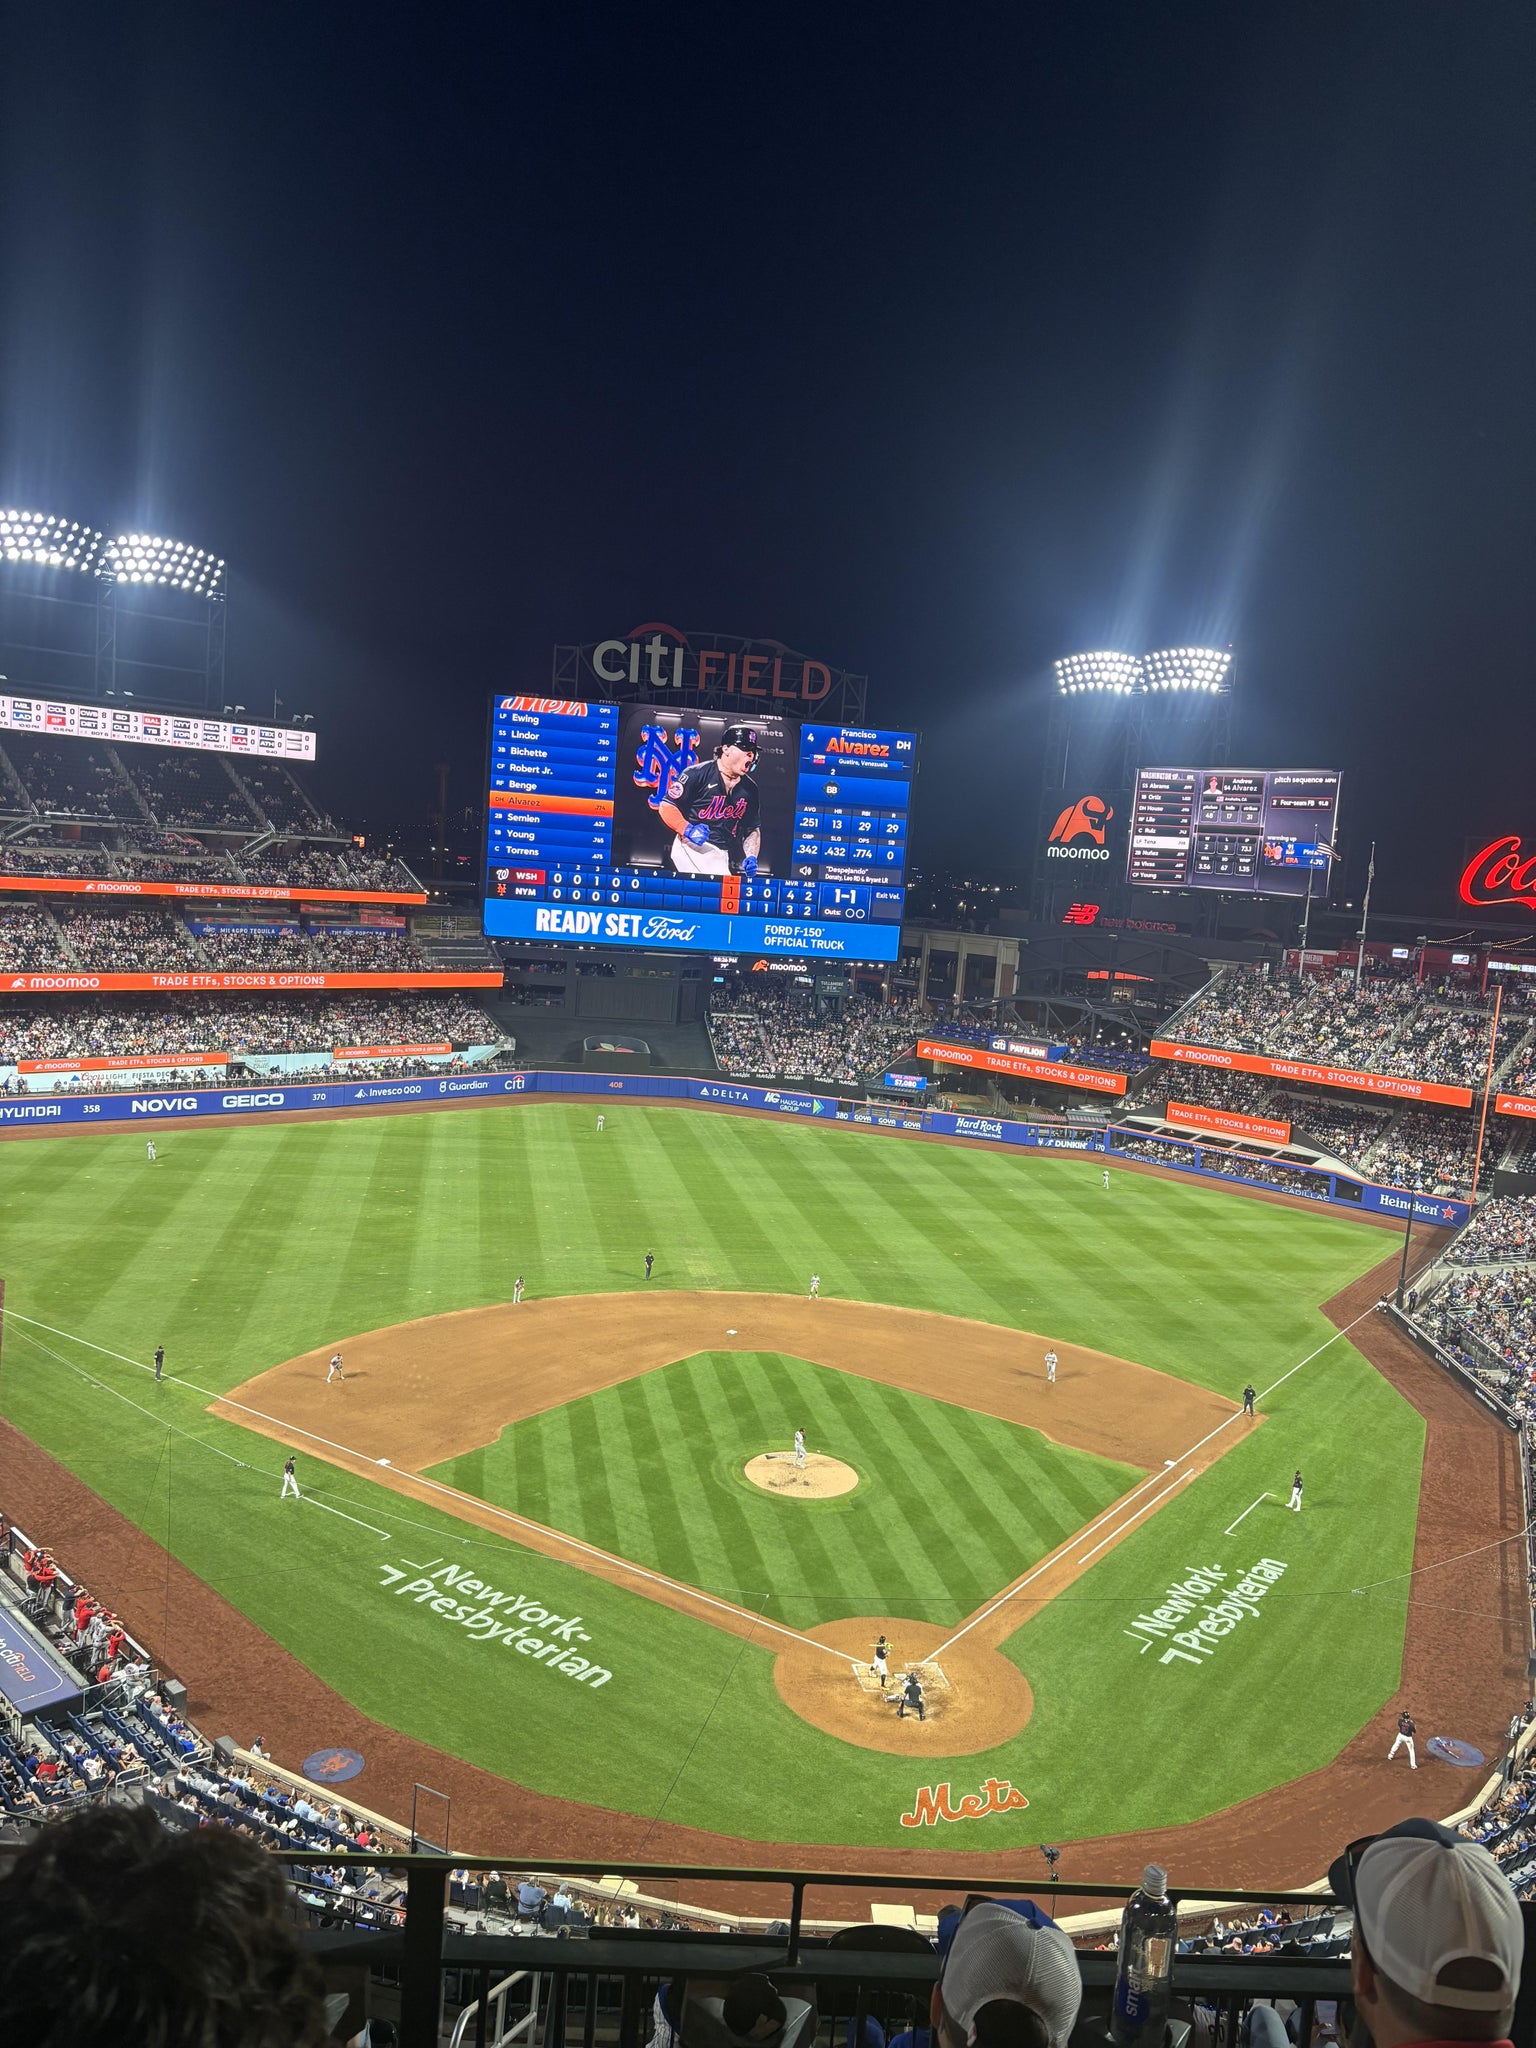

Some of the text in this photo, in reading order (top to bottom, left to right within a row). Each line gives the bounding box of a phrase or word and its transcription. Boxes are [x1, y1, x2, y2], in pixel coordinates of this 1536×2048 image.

[593, 634, 832, 701] citi FIELD
[174, 720, 190, 728] NYY
[512, 713, 540, 726] Ewing
[511, 730, 540, 741] Lindor
[807, 733, 815, 743] 4
[841, 729, 877, 739] Francisco
[826, 737, 890, 757] Alvarez
[896, 740, 911, 750] DH
[510, 746, 548, 758] Bichette
[509, 764, 553, 775] Robert Jr.
[509, 780, 538, 792] Benge
[1274, 776, 1324, 785] pitch sequence
[508, 796, 541, 807] Alvarez
[507, 813, 540, 824] Semien
[800, 818, 819, 828] .251
[832, 820, 843, 829] 13
[858, 822, 871, 831] 29
[886, 824, 899, 834] 29
[506, 829, 536, 842] Young
[505, 845, 540, 857] Torrens
[796, 845, 818, 855] .342
[824, 847, 846, 857] .432
[853, 849, 873, 859] .774
[886, 851, 895, 860] 0
[1047, 846, 1110, 861] moomoo
[97, 883, 142, 892] moomoo
[175, 886, 200, 894] TRADE
[201, 887, 220, 895] ETFs,
[221, 888, 251, 896] STOCKS
[258, 889, 291, 897] OPTIONS
[516, 871, 538, 881] WSH
[553, 873, 562, 883] 0
[573, 874, 582, 885] 0
[594, 876, 599, 886] 1
[612, 877, 621, 887] 0
[631, 878, 640, 889] 0
[745, 888, 753, 897] 3
[763, 889, 772, 899] 0
[787, 890, 795, 900] 4
[804, 892, 812, 901] 2
[515, 887, 537, 897] NYM
[552, 888, 562, 899] 0
[572, 890, 581, 900] 0
[592, 891, 601, 901] 0
[611, 892, 620, 903] 0
[726, 902, 734, 910] 0
[785, 905, 793, 915] 3
[803, 906, 811, 916] 2
[536, 908, 697, 942] READY SET Ford
[764, 924, 793, 936] FORD
[1126, 918, 1177, 933] balance
[763, 935, 845, 951] OFFICIAL TRUCK
[770, 963, 808, 972] moomoo
[30, 975, 326, 989] moomoo TRADE ETFs, STOCKS & OPTIONS
[1009, 1043, 1046, 1057] PAVILION
[44, 1061, 81, 1070] moomoo
[932, 1049, 1117, 1088] moomoo TRADE ETFs, STOCKS & OPTIONS
[1185, 1050, 1422, 1095] moomoo TRADE ETFs, STOCKS & OPTIONS
[448, 1080, 489, 1092] Guardian
[504, 1076, 525, 1090] citi
[608, 1081, 624, 1089] 408
[312, 1092, 326, 1101] 370
[369, 1085, 422, 1097] Invesco QQQ
[712, 1088, 749, 1101] DELTA
[131, 1098, 198, 1113] NOVIG
[222, 1093, 285, 1108] GEICO
[780, 1098, 812, 1108] HAUGLAND
[83, 1104, 101, 1113] 358
[779, 1104, 800, 1113] GROUP
[835, 1111, 849, 1120] 380
[853, 1114, 872, 1123] GOYA
[878, 1117, 896, 1127] GOYA
[903, 1120, 921, 1130] GOYA
[956, 1117, 980, 1129] Hard
[980, 1120, 1003, 1134] Rock
[1171, 1109, 1287, 1137] TRADE ETFs, STOCKS & OPTIONS
[1094, 1143, 1106, 1152] 370
[1125, 1152, 1168, 1167] CADILLAC
[1281, 1187, 1331, 1202] CADILLAC
[1171, 1557, 1289, 1655] Presbyterian
[394, 1578, 614, 1688] Presbyterian
[10, 1661, 36, 1682] FIELD
[900, 1777, 1030, 1828] Mets
